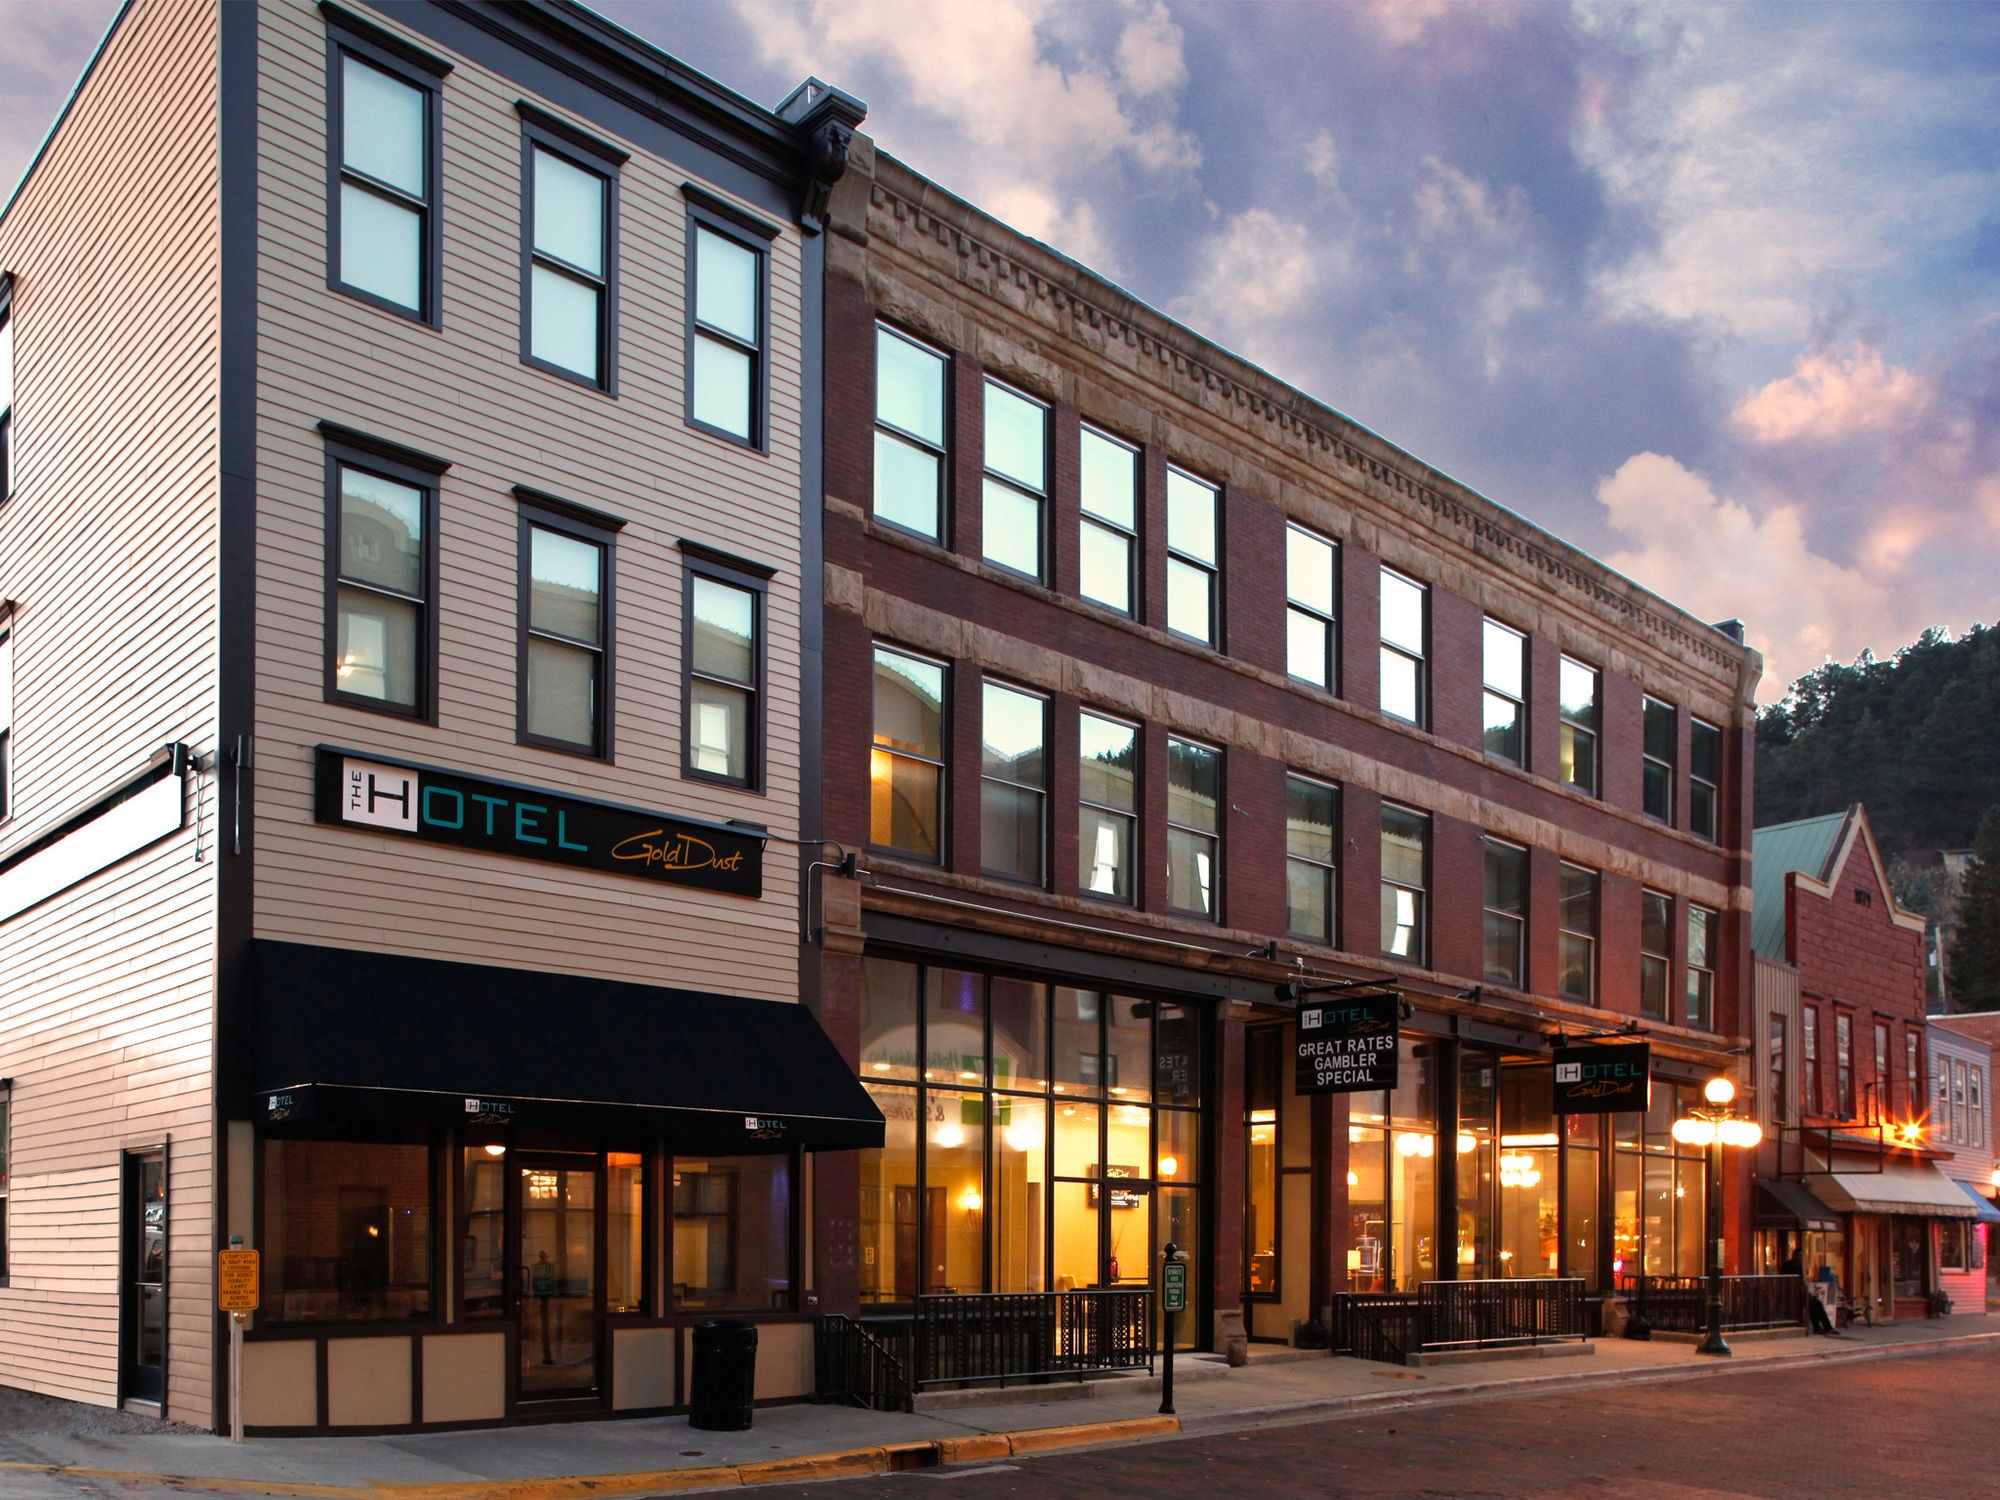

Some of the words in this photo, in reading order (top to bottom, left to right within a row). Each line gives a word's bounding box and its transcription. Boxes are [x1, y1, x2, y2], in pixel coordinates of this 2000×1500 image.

[351, 770, 361, 810] THE
[368, 773, 588, 853] HOTEL
[1308, 1007, 1374, 1026] HOTEL
[1298, 1040, 1342, 1057] GREAT
[1347, 1035, 1394, 1053] RATES
[1314, 1052, 1377, 1071] GAMBLER
[1316, 1068, 1374, 1087] SPECIAL
[1564, 1063, 1644, 1080] HOTEL
[469, 1101, 517, 1113] HOTEL
[749, 1119, 787, 1129] HOTEL
